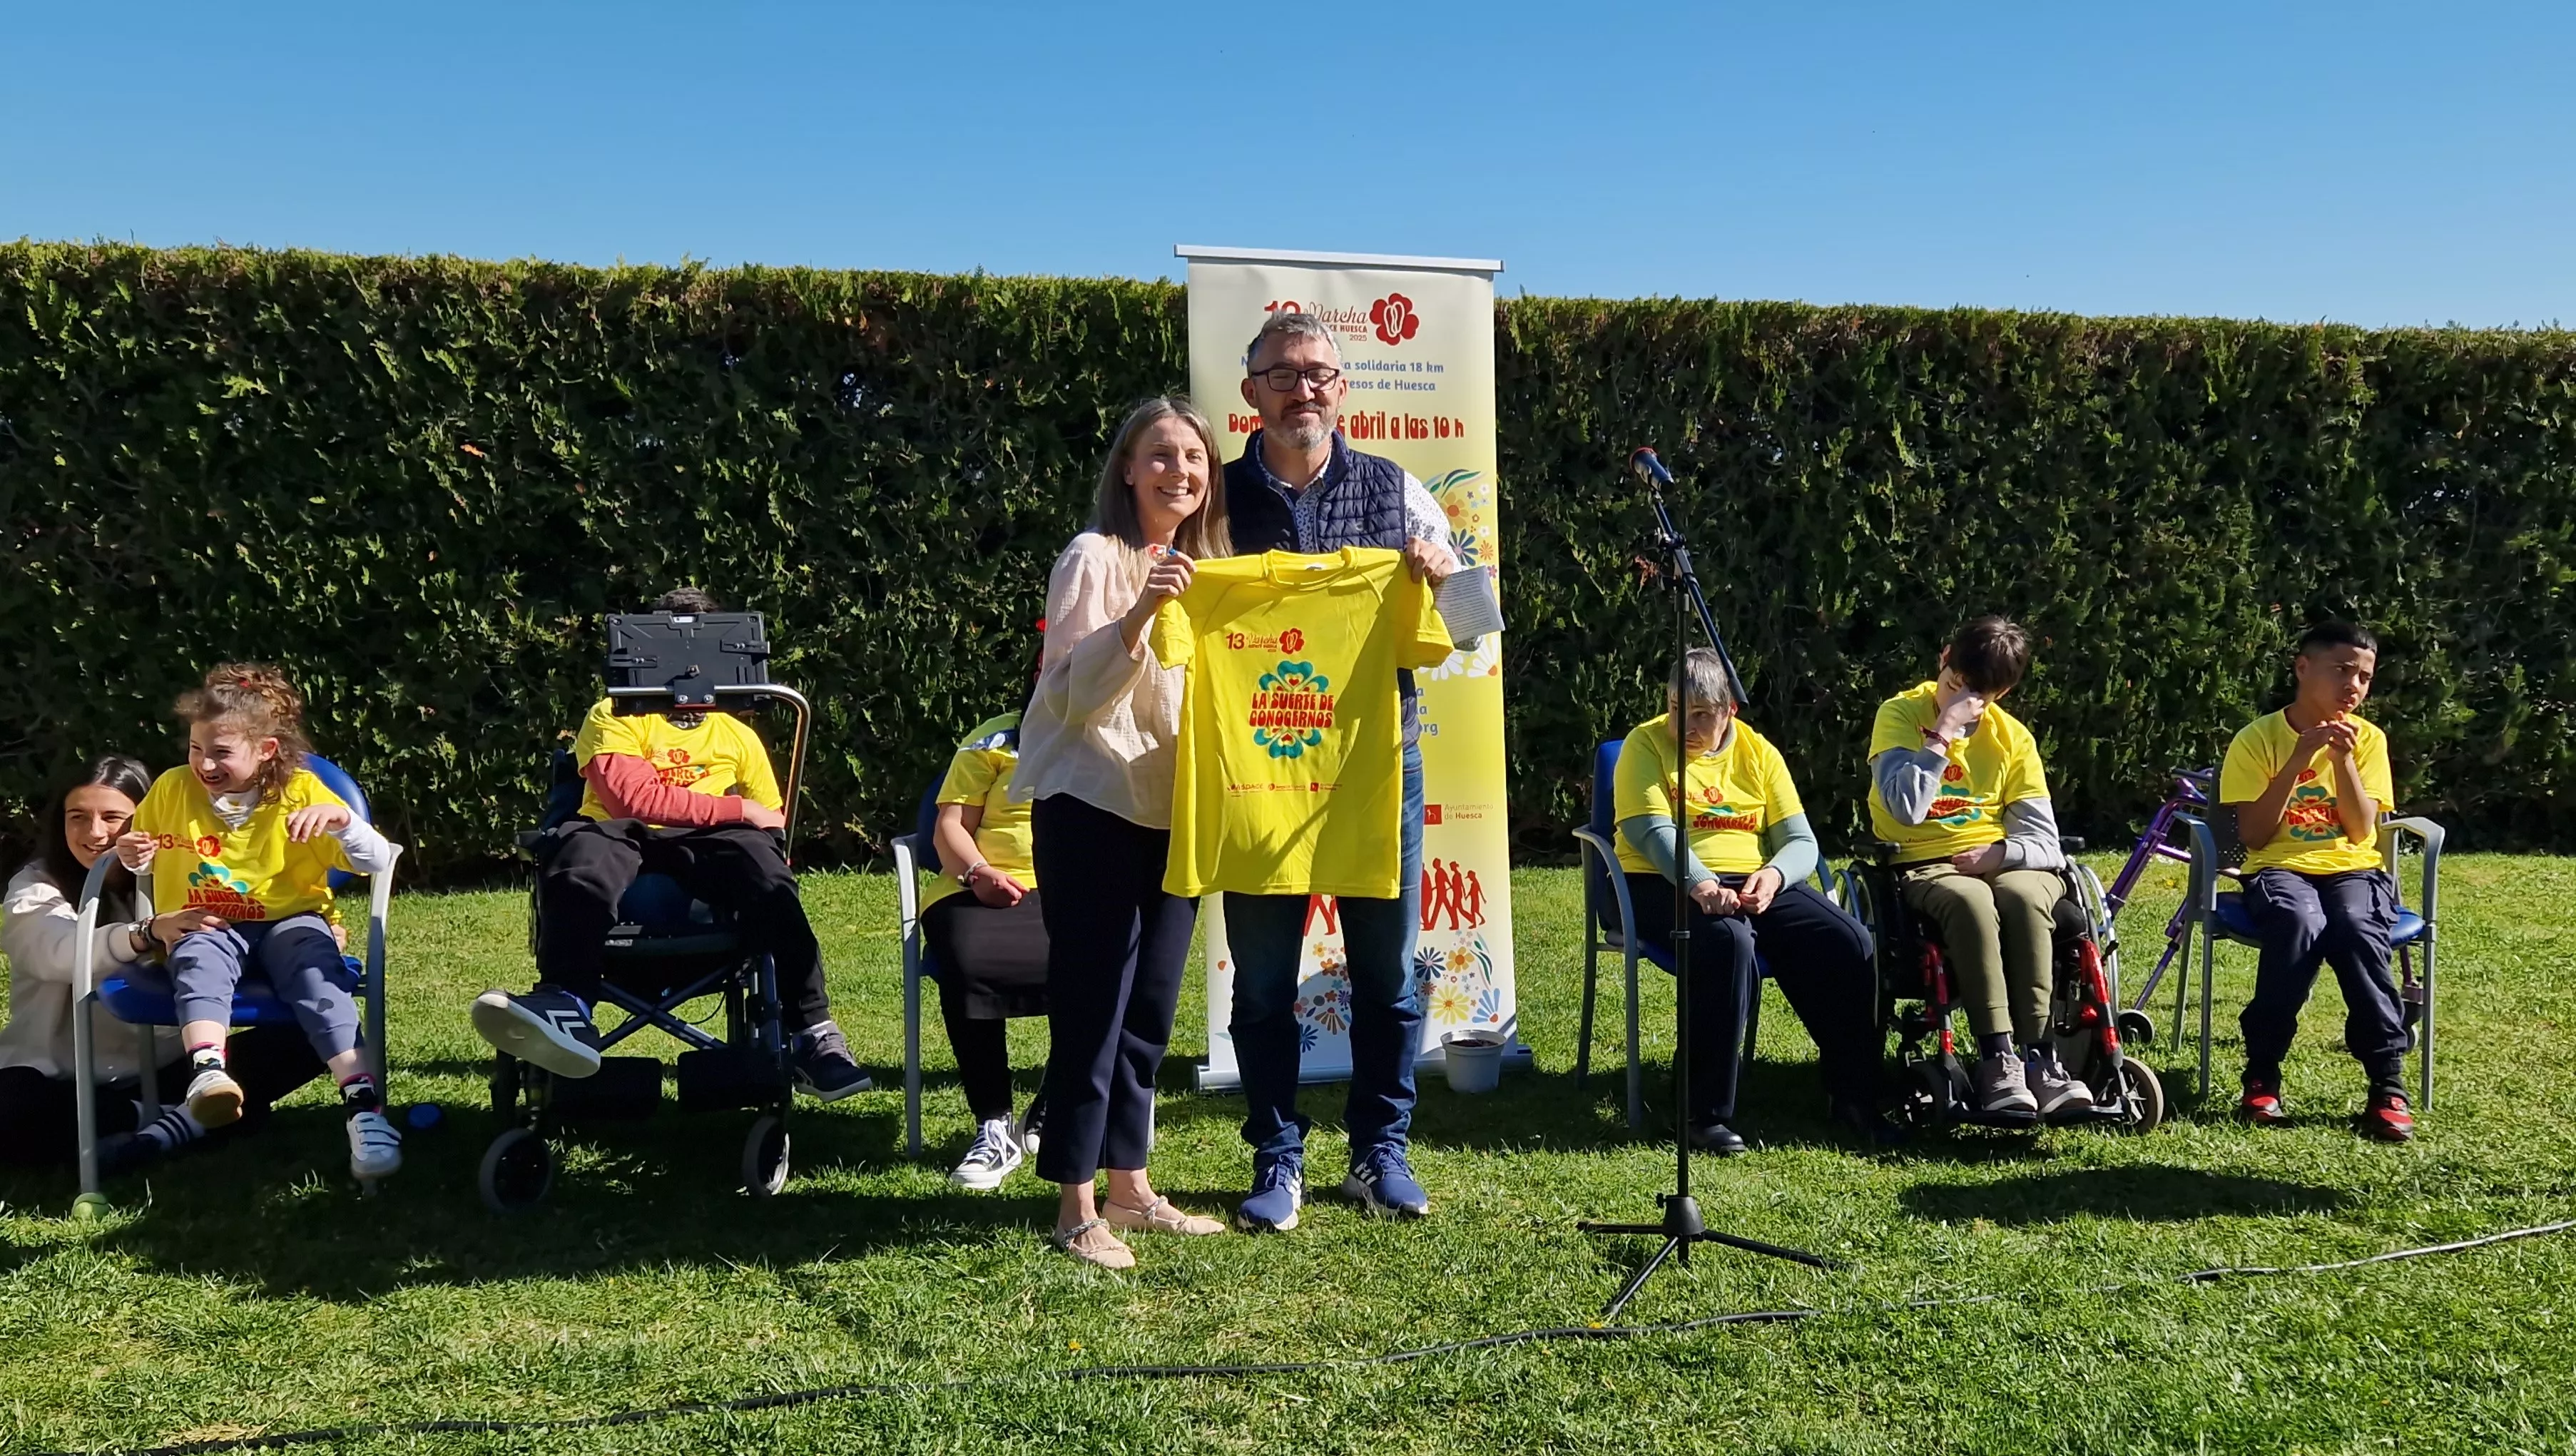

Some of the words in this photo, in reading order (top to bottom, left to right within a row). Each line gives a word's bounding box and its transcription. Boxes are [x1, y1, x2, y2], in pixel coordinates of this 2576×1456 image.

[1304, 302, 1367, 324] Marcha
[1355, 360, 1406, 372] solidaria
[1410, 362, 1422, 372] 18
[1426, 361, 1444, 373] km
[1378, 379, 1391, 390] de
[1395, 380, 1436, 391] Huesca
[1350, 410, 1386, 439] abril
[1390, 417, 1400, 439] a
[1405, 413, 1429, 439] las
[1433, 416, 1450, 438] 10
[1455, 418, 1464, 438] h
[1226, 633, 1245, 649] 13
[1252, 693, 1267, 709] LA
[1271, 692, 1315, 710] SUERTE
[1319, 695, 1333, 711] DE
[1249, 710, 1333, 728] CONOCERNOS
[1444, 803, 1494, 812] Ayuntamiento
[158, 834, 174, 849] 13
[188, 888, 203, 902] LA
